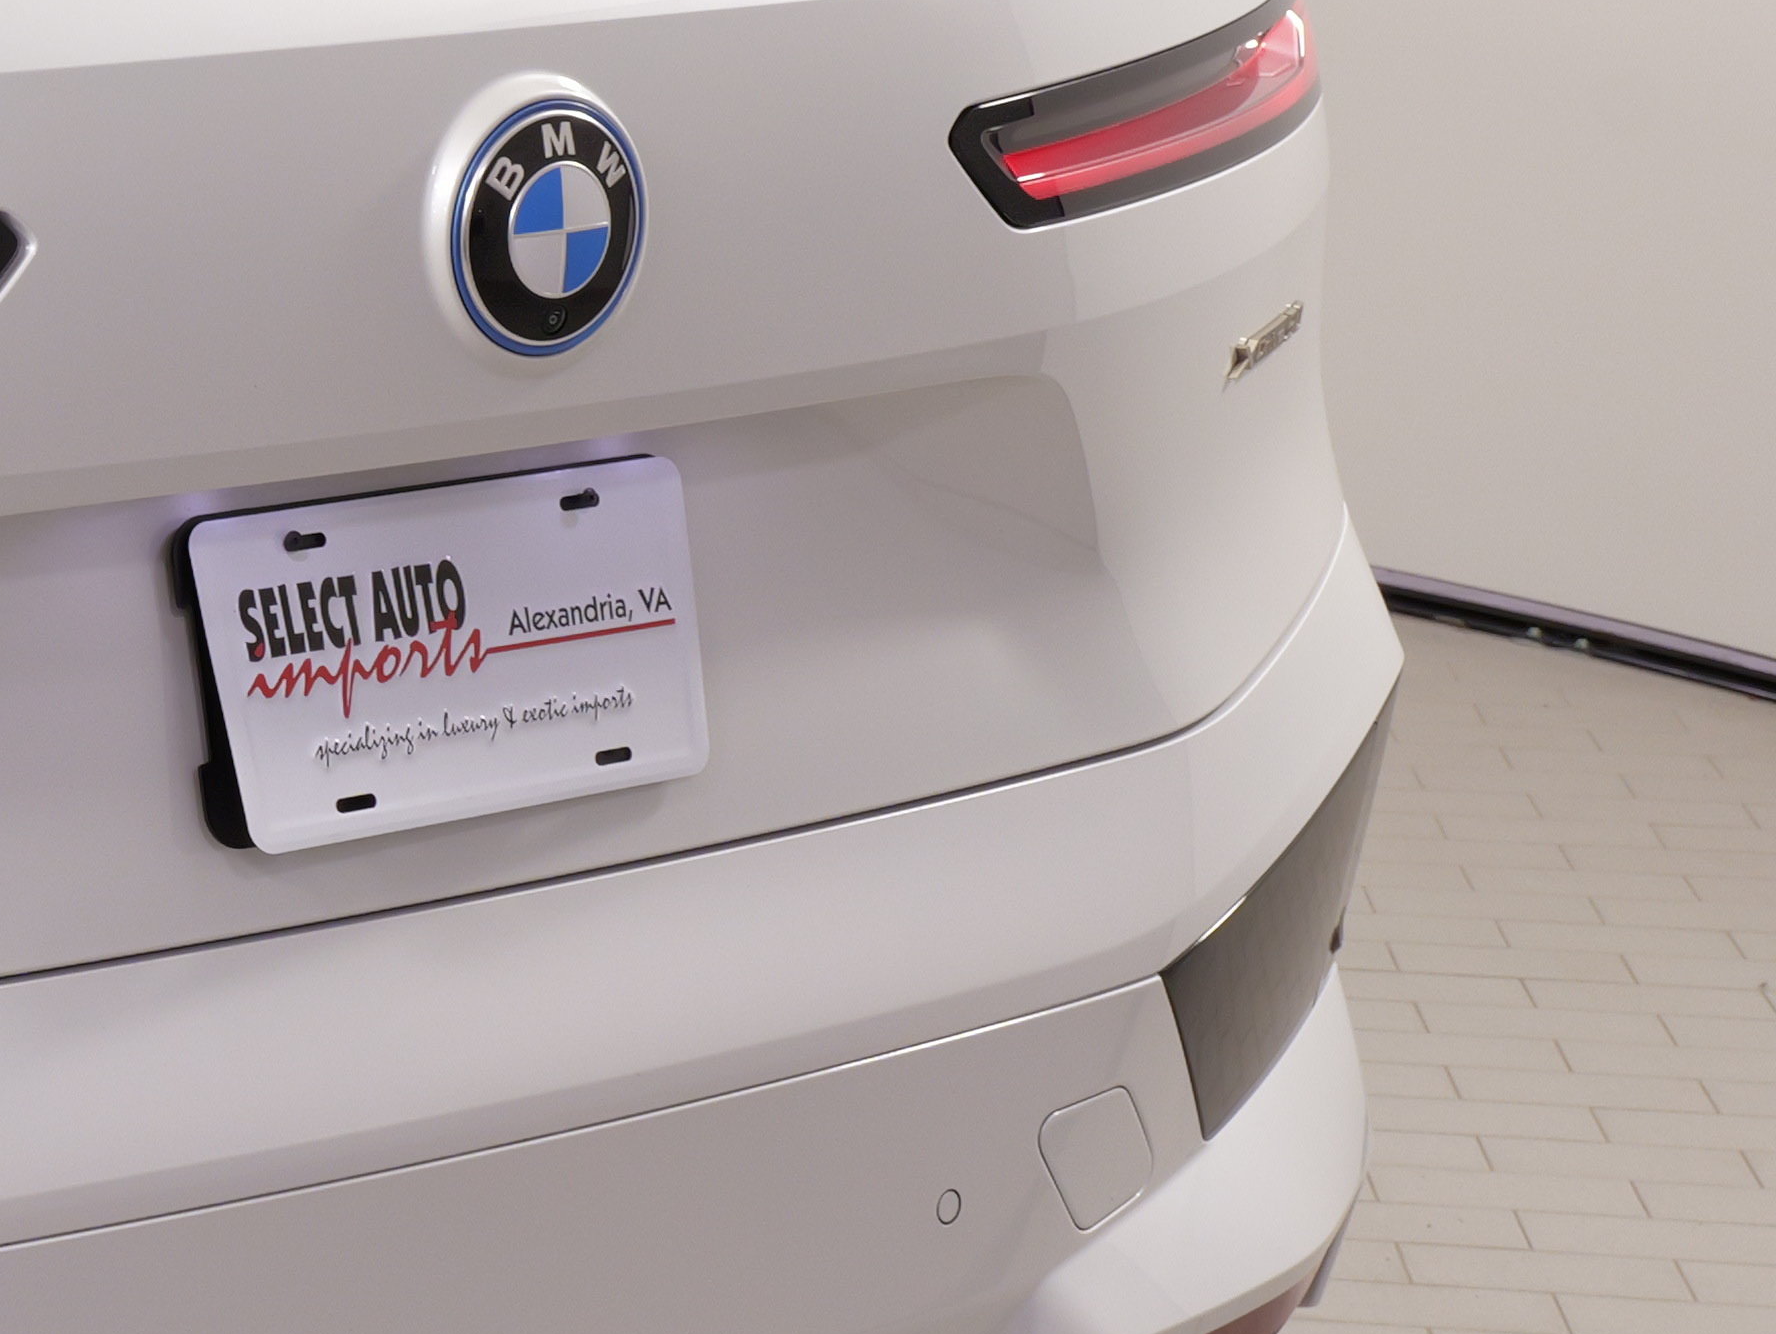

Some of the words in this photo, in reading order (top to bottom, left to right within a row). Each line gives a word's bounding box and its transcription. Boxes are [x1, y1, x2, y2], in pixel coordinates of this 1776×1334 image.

[485, 121, 626, 201] BMW
[238, 575, 362, 662] SELECT
[372, 559, 466, 642] AUTO
[508, 593, 633, 636] Alexandria,
[638, 587, 672, 613] VA
[247, 610, 484, 719] imports
[314, 722, 415, 767] specializing
[418, 719, 439, 741] in
[443, 708, 499, 741] luxury
[522, 697, 569, 724] exotic
[573, 687, 634, 720] imports
